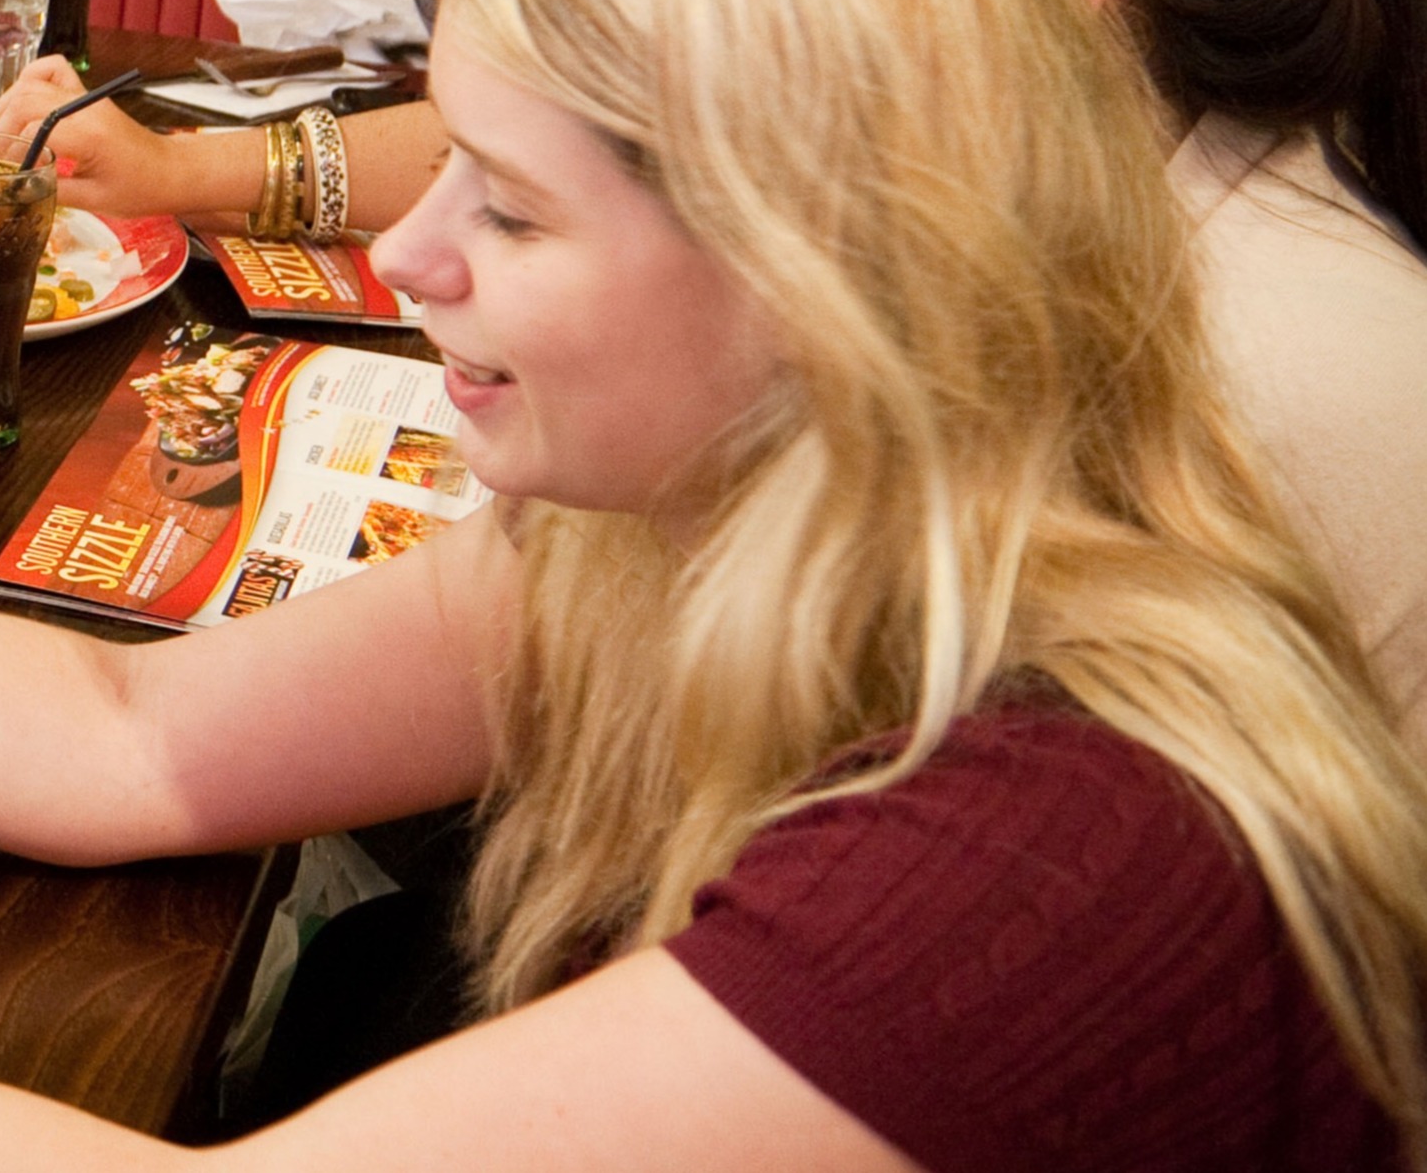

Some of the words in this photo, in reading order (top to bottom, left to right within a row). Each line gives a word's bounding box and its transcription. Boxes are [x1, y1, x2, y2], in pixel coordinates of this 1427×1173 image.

[216, 236, 283, 298] SOUTHERN
[16, 504, 90, 575] SOUTHERN
[58, 514, 151, 590] SIZZLE
